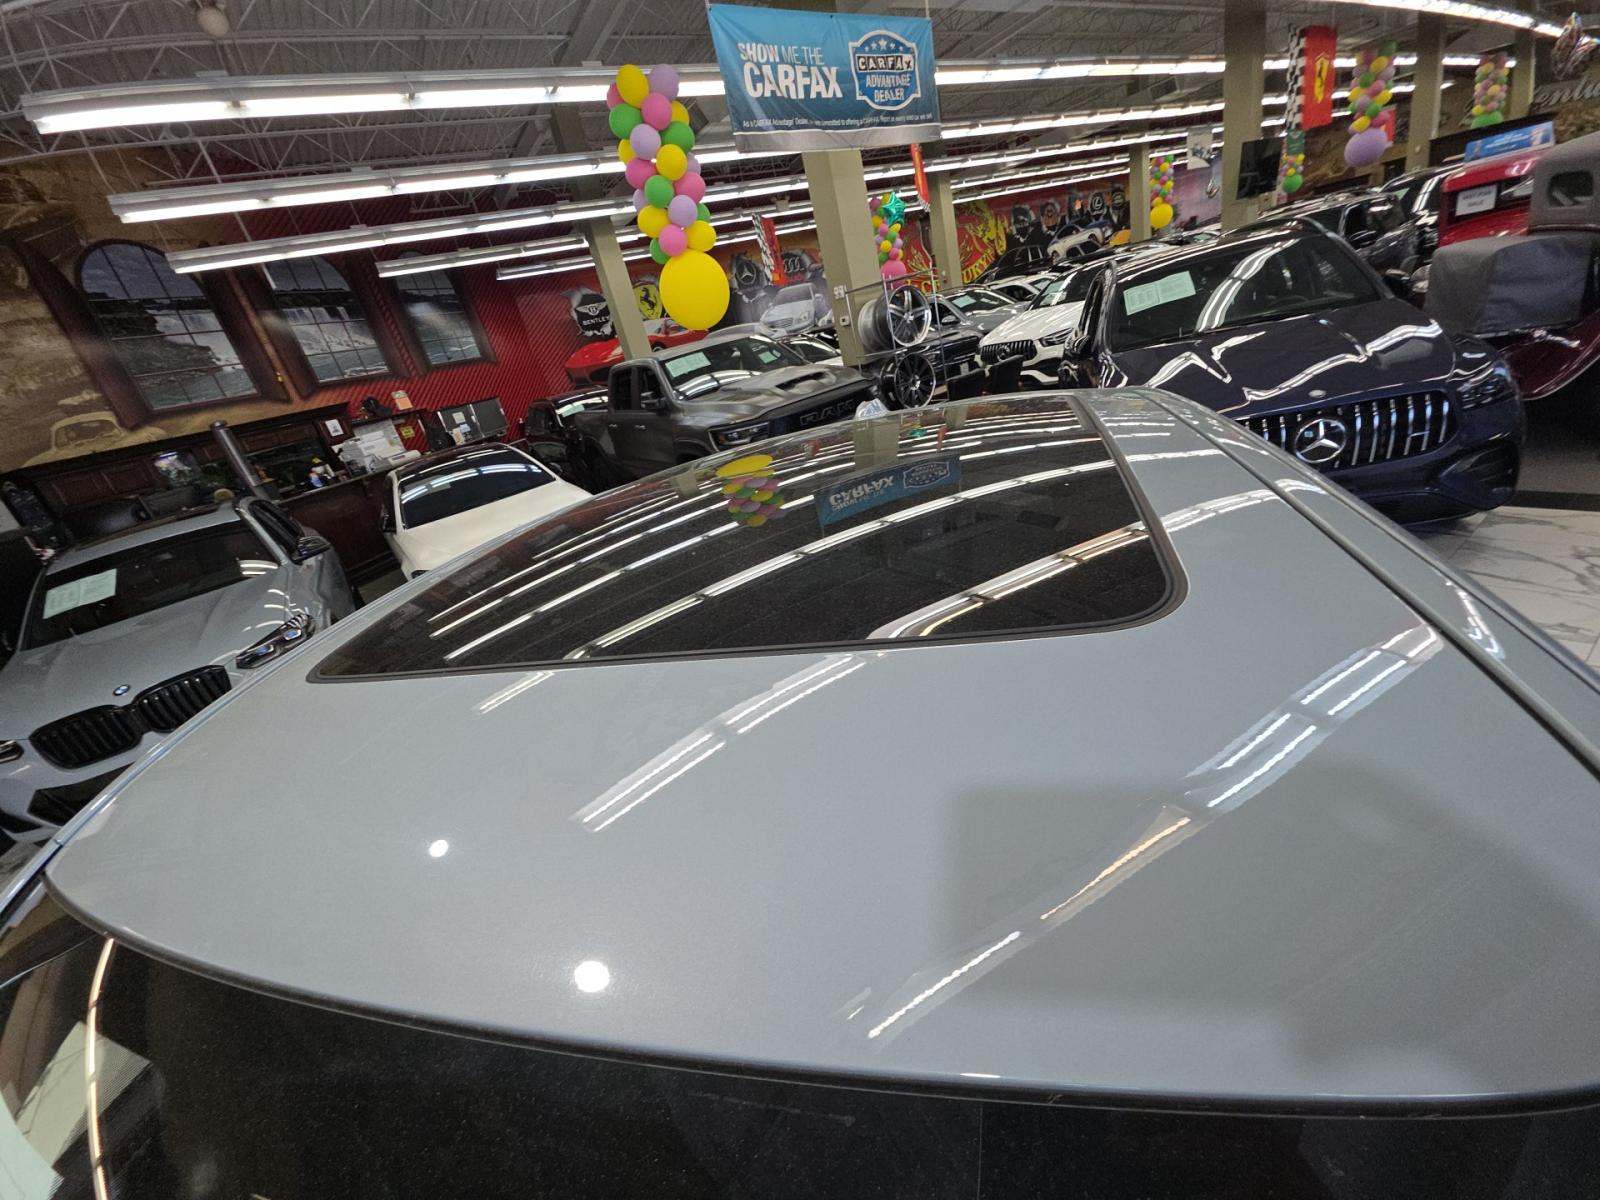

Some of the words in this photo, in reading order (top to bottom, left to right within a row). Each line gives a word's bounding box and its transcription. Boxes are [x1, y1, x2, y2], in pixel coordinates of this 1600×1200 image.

[737, 42, 780, 63] SHOW
[781, 45, 801, 64] ME
[801, 46, 825, 66] THE
[859, 56, 912, 70] CARFAX
[743, 61, 843, 99] CARFAX
[866, 74, 912, 88] ADVANTAGE
[874, 88, 905, 102] DEALER
[582, 315, 610, 326] BENTLEY
